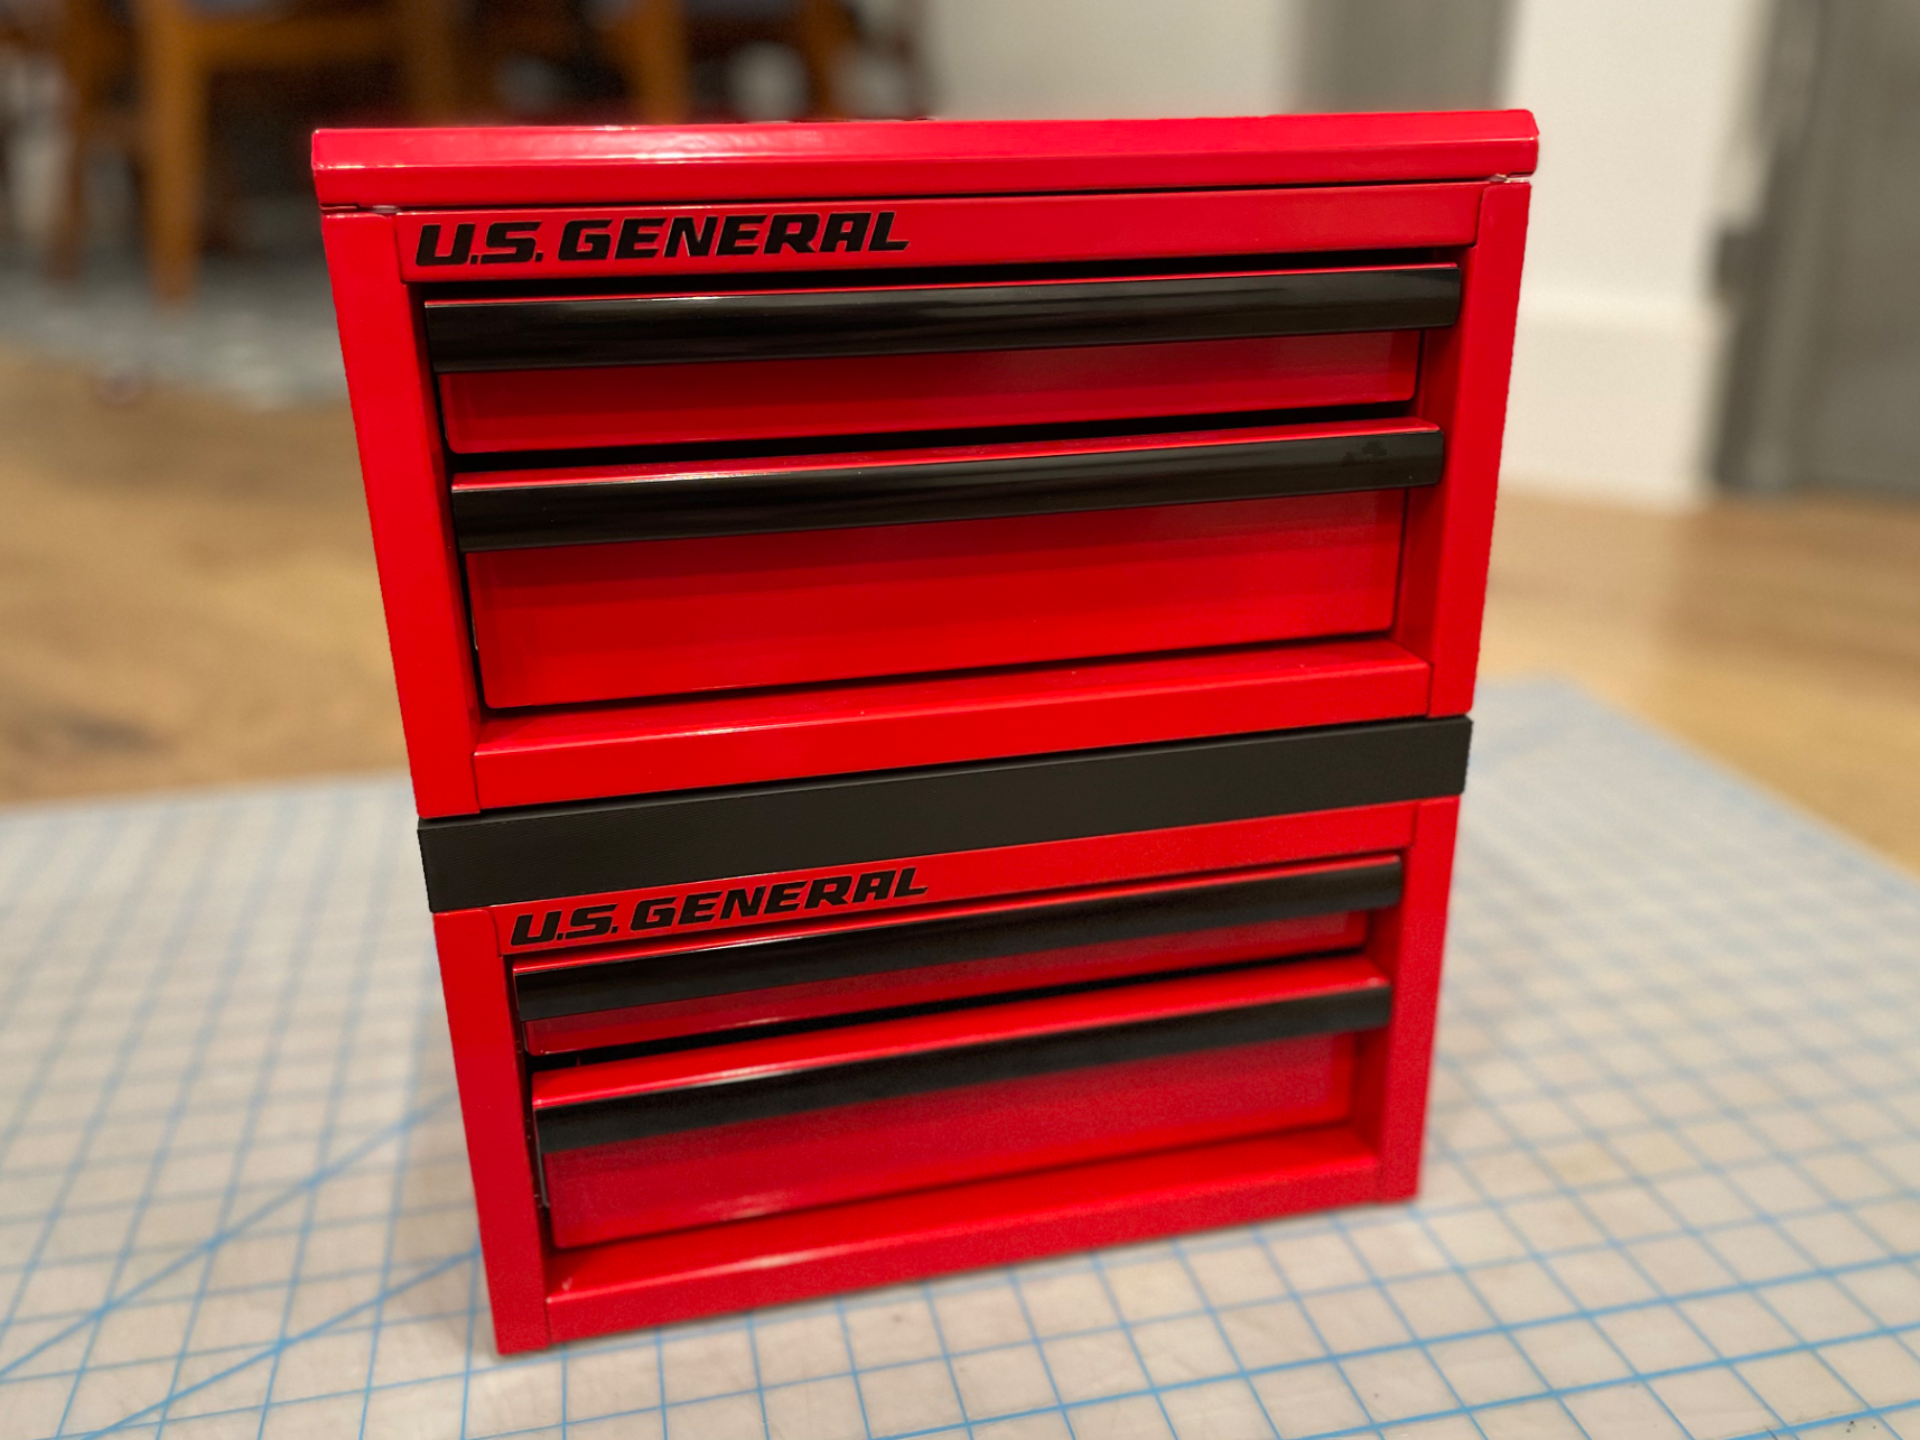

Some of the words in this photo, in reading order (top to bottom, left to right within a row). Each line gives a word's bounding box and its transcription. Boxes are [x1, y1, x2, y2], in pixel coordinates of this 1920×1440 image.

[415, 221, 544, 267] U.S.
[557, 211, 910, 262] GENERAL
[510, 903, 619, 946] U.S.
[630, 867, 928, 931] GENERAL
